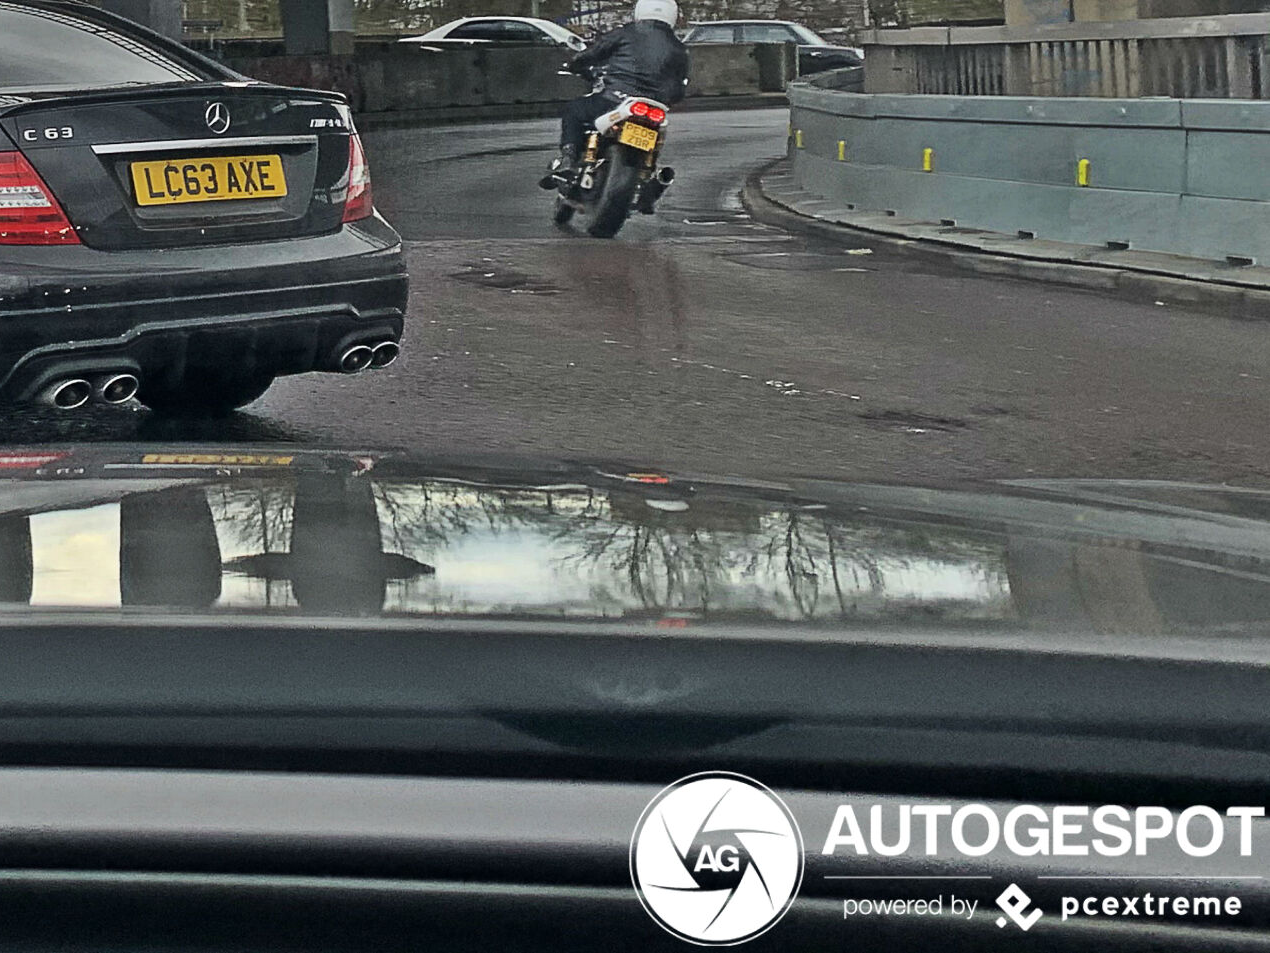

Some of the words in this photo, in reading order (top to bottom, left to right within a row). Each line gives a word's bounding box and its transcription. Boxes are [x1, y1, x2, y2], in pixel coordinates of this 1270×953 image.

[23, 128, 37, 141] C
[44, 126, 73, 139] 63
[144, 163, 218, 199] LC63
[228, 160, 276, 193] AXE
